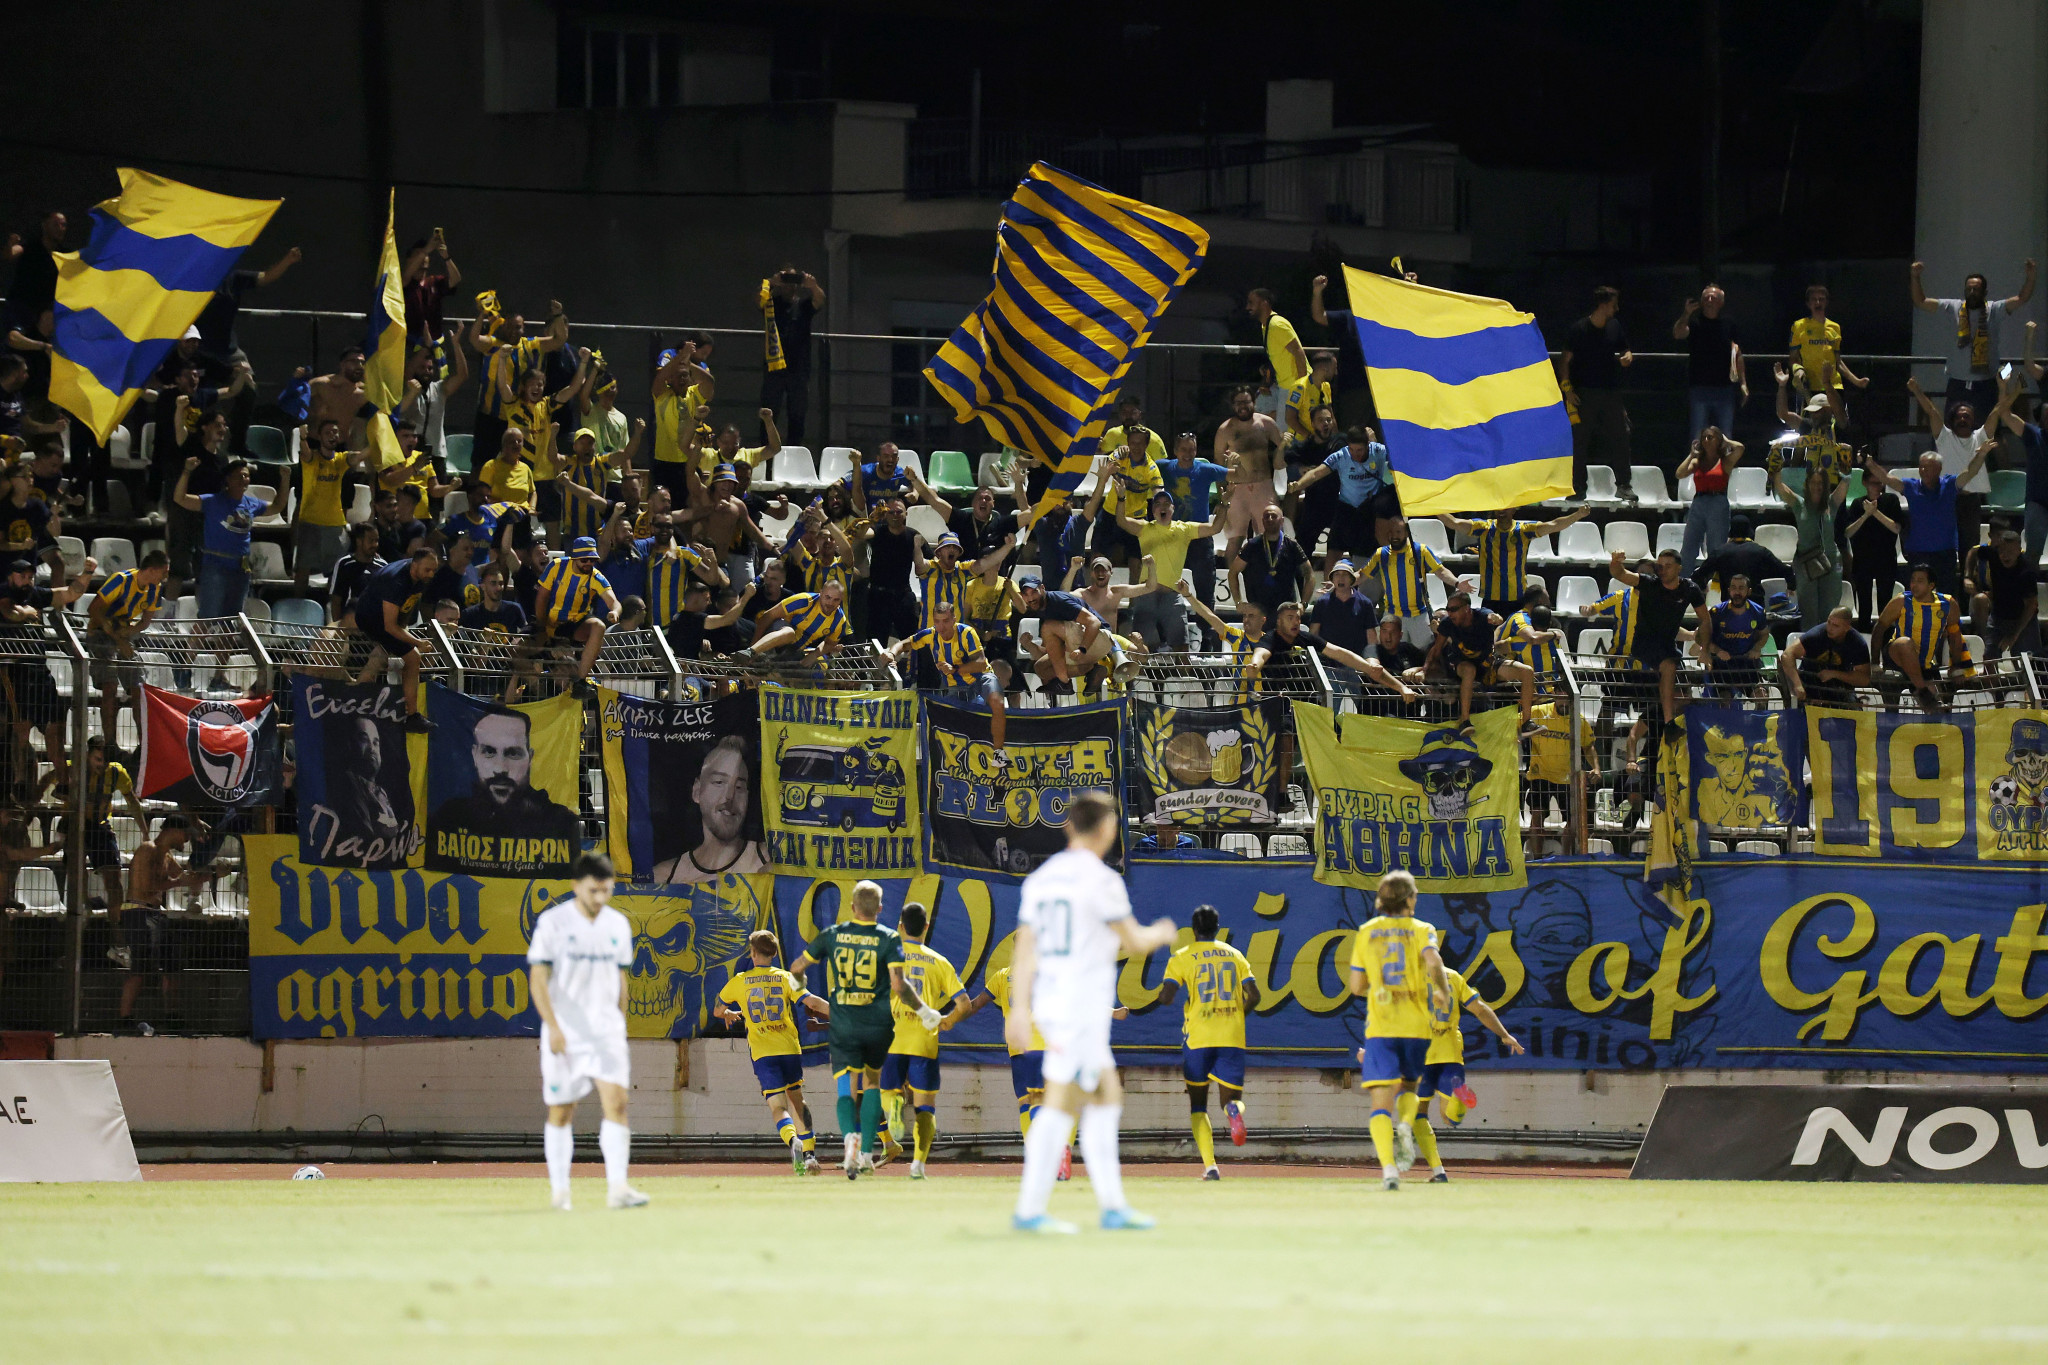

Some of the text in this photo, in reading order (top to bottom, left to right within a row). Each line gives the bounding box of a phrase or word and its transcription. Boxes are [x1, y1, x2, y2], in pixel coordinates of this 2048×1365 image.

[933, 728, 1115, 782] YOUTH
[206, 784, 245, 799] ACTION
[1070, 772, 1104, 787] 2010
[937, 774, 1114, 826] BLOC
[1400, 796, 1421, 825] 6
[459, 856, 544, 872] Warriors of Gate 6
[499, 837, 571, 864] ΠΑΡΩΝ
[766, 830, 917, 869] ΚΑΙ ΤΑΞΙΔΙΑ
[1322, 815, 1513, 880] ΑΘΗΝΑ
[834, 946, 878, 990] 99
[1195, 961, 1237, 1003] 20
[1382, 941, 1406, 986] 2
[1565, 898, 1717, 1041] of
[745, 986, 784, 1023] 65
